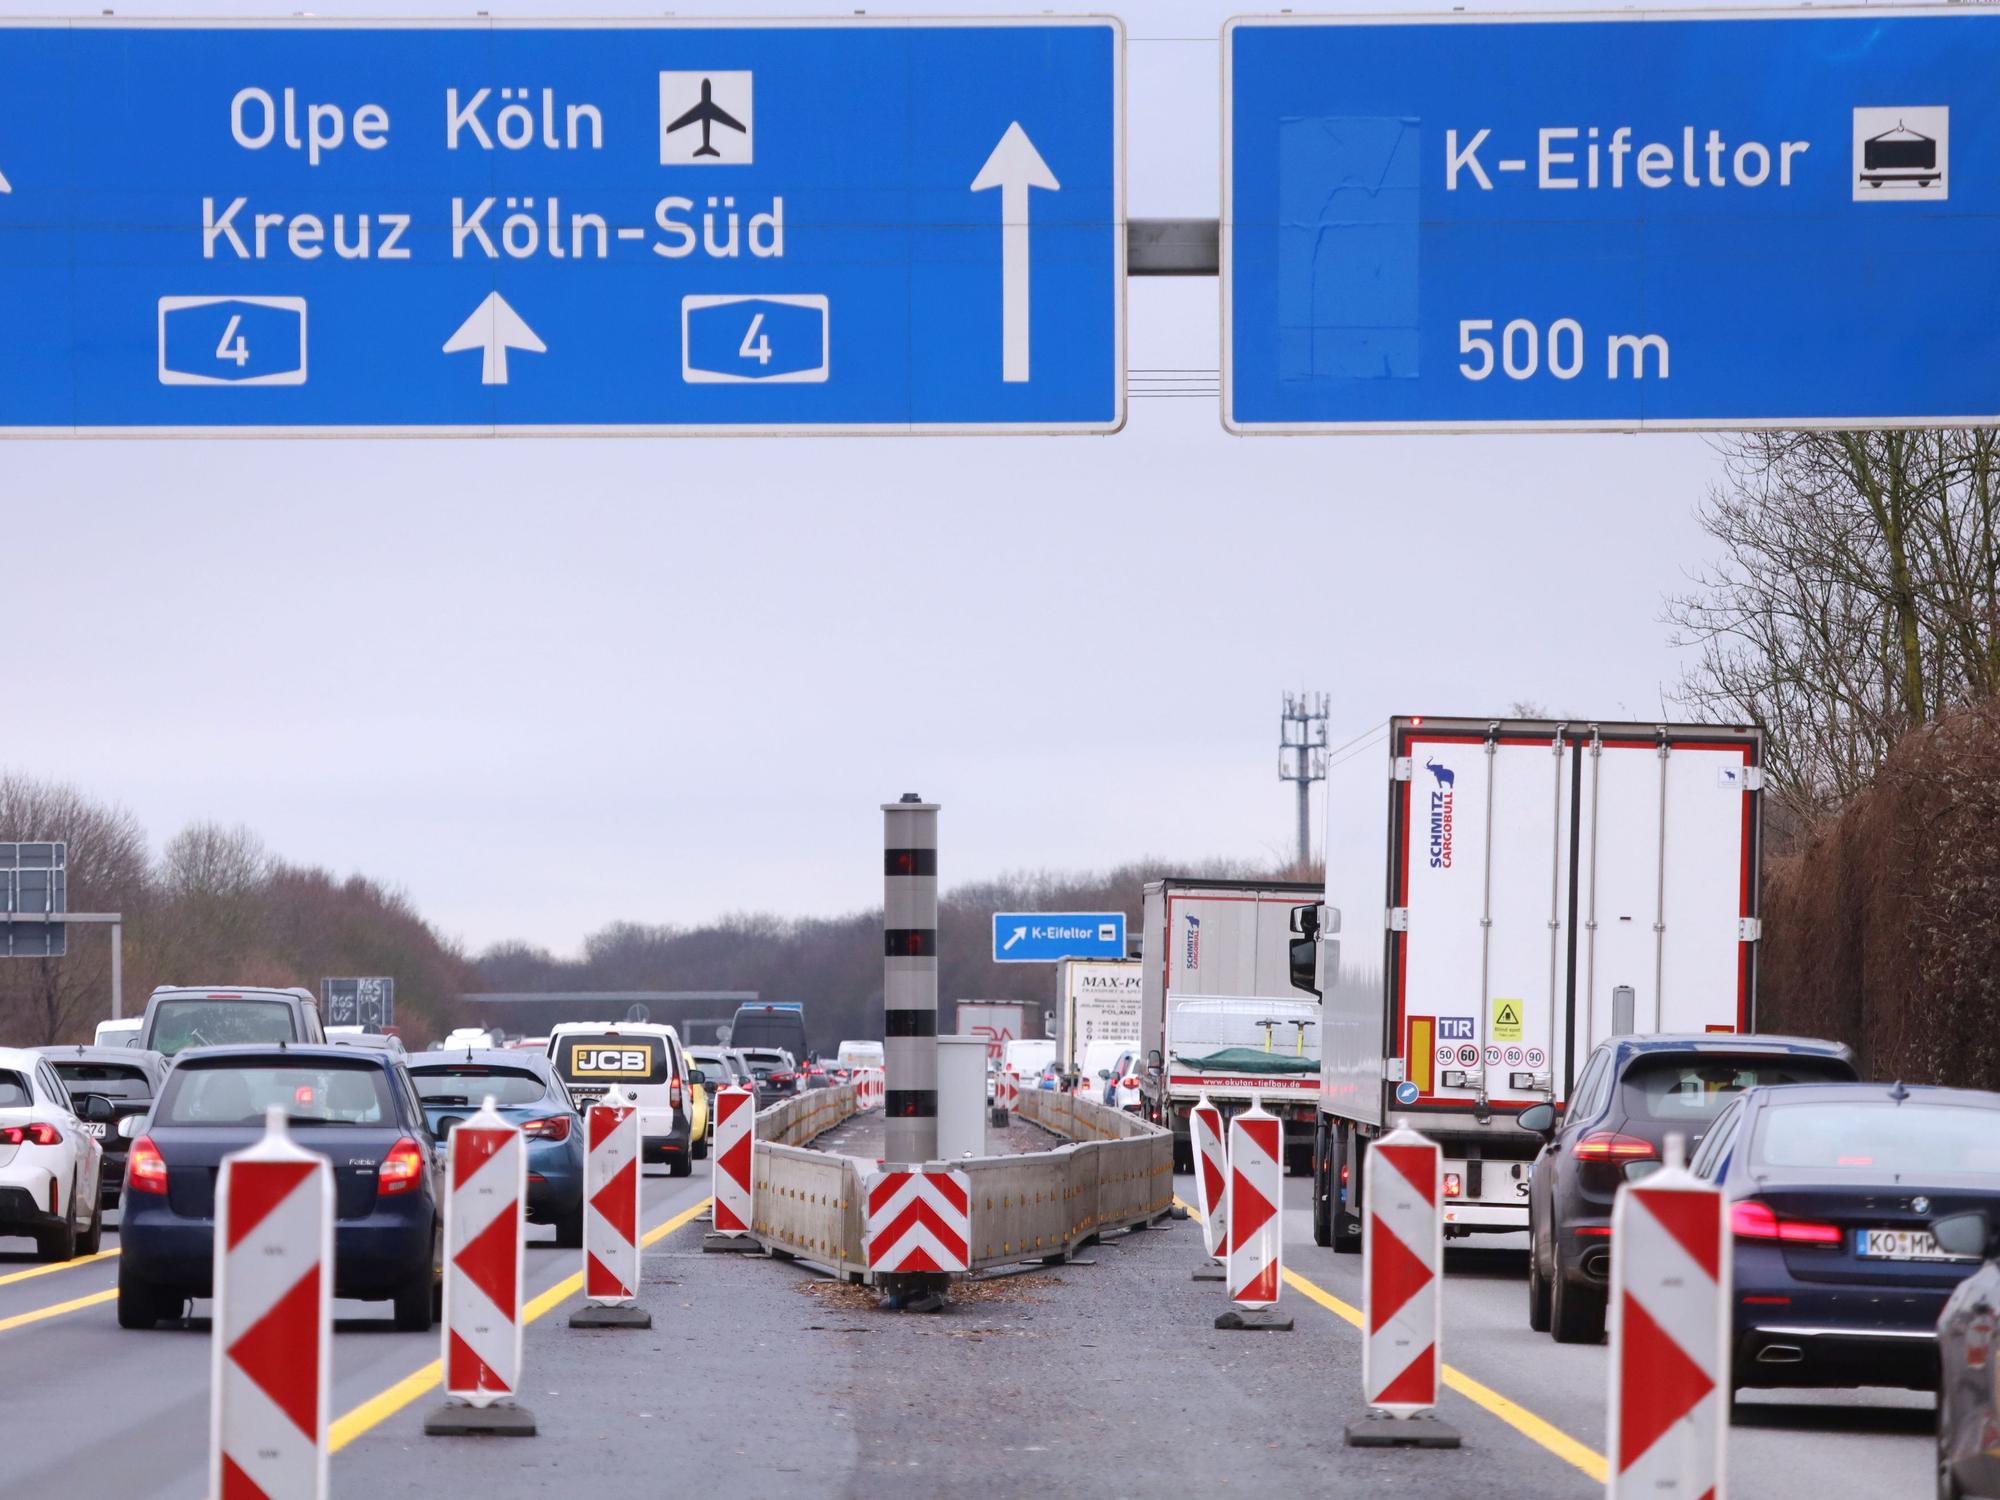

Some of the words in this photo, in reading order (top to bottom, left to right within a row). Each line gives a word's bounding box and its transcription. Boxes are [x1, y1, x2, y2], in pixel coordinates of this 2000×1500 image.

[230, 87, 390, 167] Olpe
[446, 87, 604, 151] Köln
[1445, 126, 1811, 191] K-Eifeltor
[202, 197, 412, 260] Kreuz
[452, 195, 785, 260] Köln-Süd
[215, 315, 250, 366] 4
[739, 313, 773, 365] 4
[1458, 317, 1585, 381] 500
[1607, 334, 1670, 380] m
[1430, 791, 1444, 868] SCHMITZ
[1443, 791, 1453, 868] CARGOBULL
[1031, 926, 1094, 939] K-Eifeltor
[1186, 930, 1194, 969] SCHMITZ
[1440, 1020, 1472, 1037] TIR
[577, 1050, 645, 1071] JCB
[1439, 1050, 1452, 1059] 50
[1460, 1050, 1475, 1062] 60
[1486, 1050, 1499, 1059] 70
[1507, 1051, 1520, 1060] 80
[1528, 1052, 1541, 1062] 90
[348, 1158, 376, 1166] Fabia
[1869, 1233, 1896, 1253] KO
